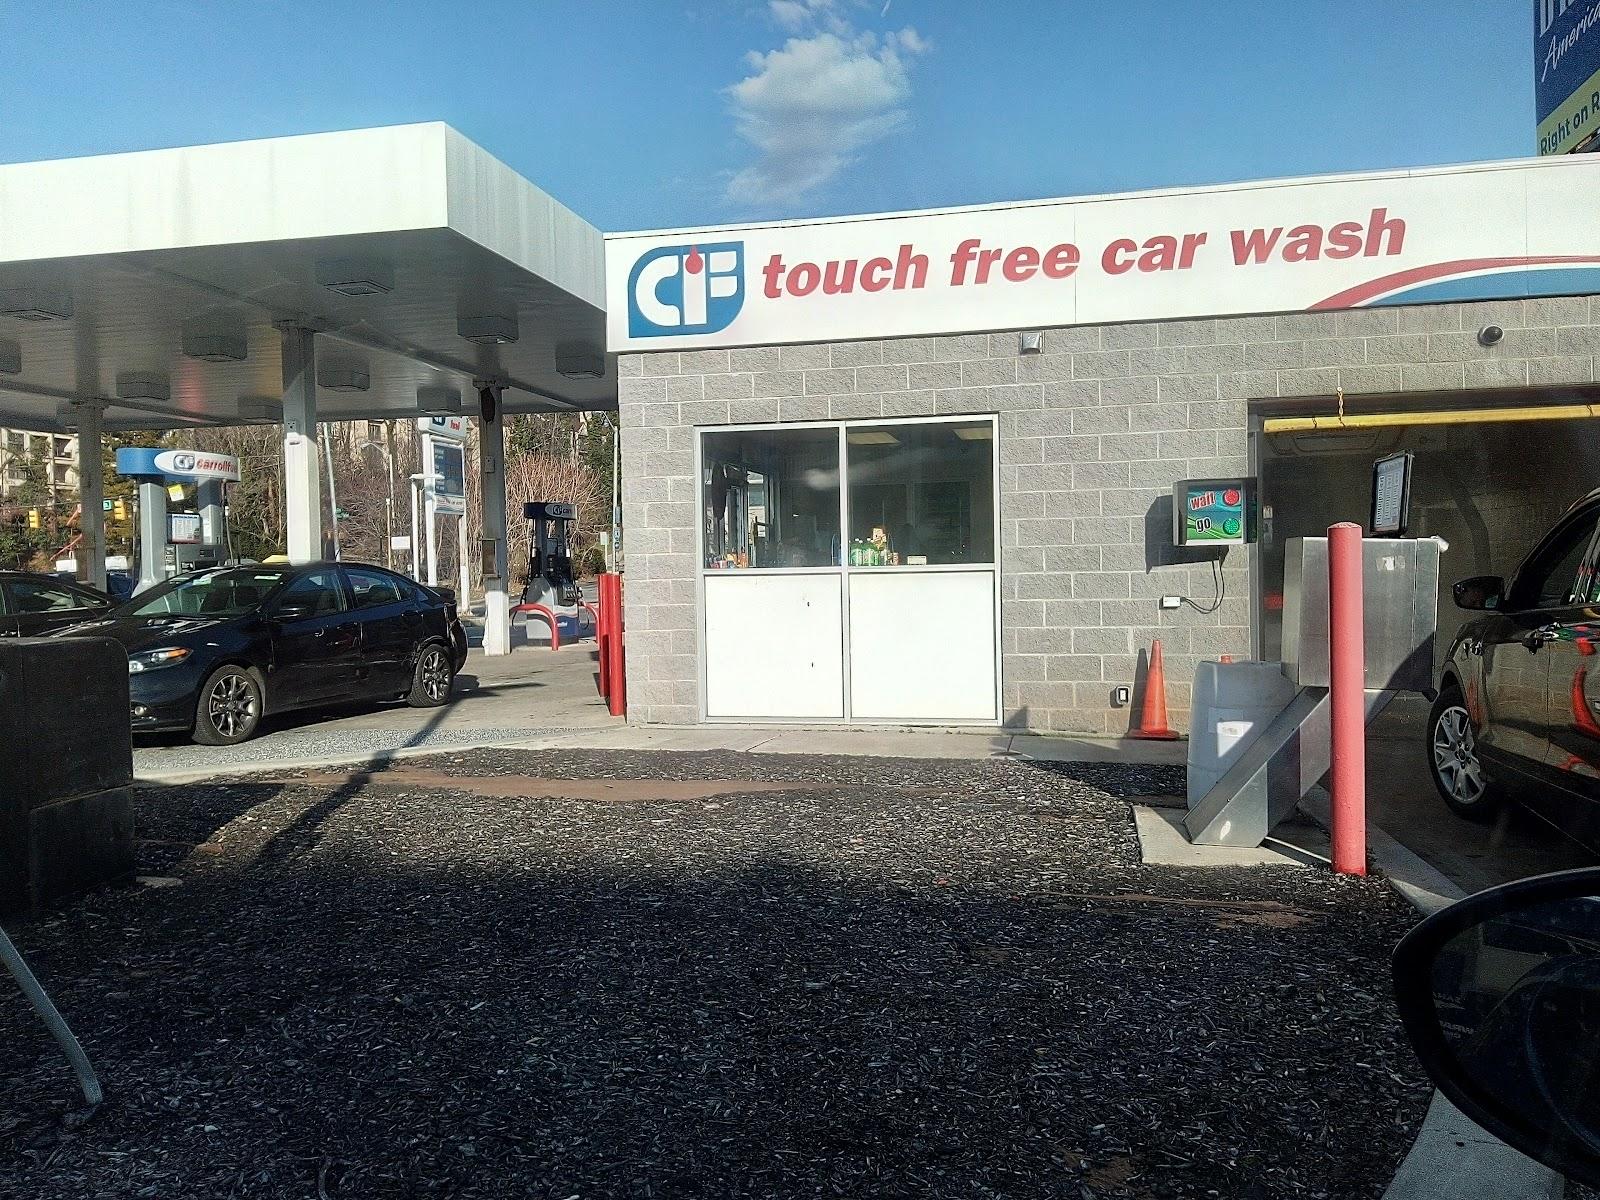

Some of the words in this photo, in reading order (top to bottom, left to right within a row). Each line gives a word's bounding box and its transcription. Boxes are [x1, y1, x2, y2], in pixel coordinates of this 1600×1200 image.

[1540, 118, 1570, 156] Right
[1573, 105, 1588, 129] on
[762, 243, 929, 299] touch
[949, 238, 1081, 287] free
[1100, 231, 1208, 276] car
[1230, 207, 1407, 267] wash
[1190, 490, 1215, 511] wait
[1196, 517, 1212, 533] go
